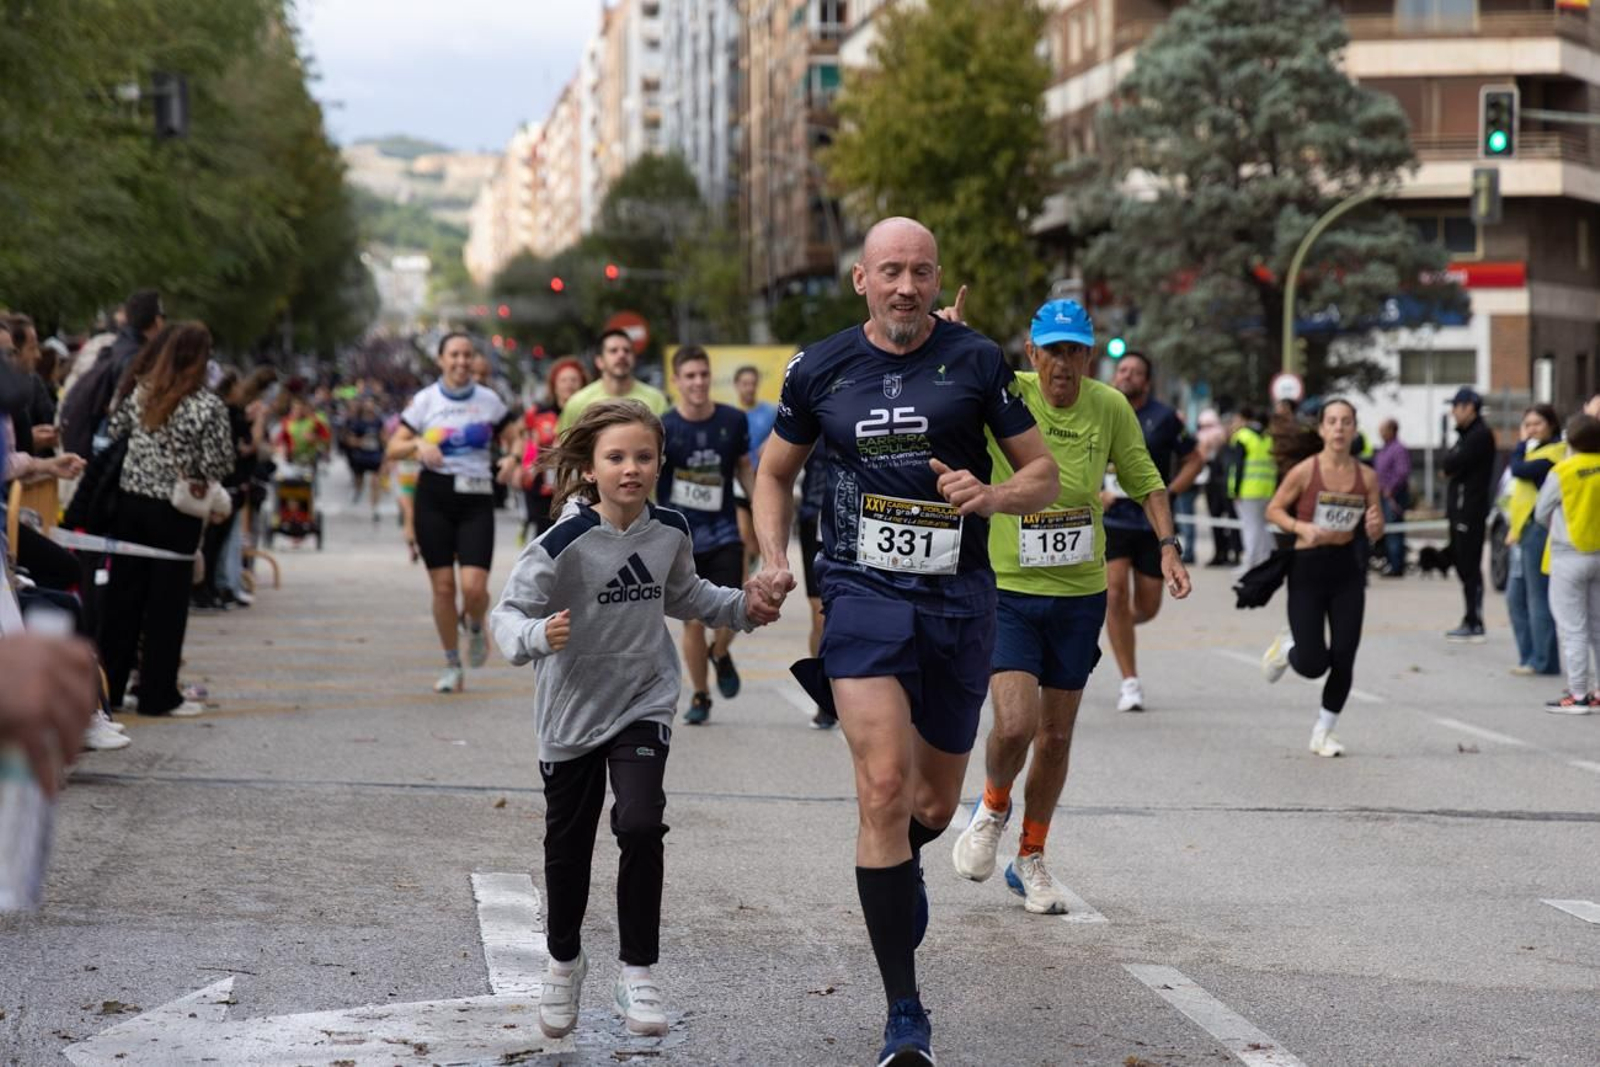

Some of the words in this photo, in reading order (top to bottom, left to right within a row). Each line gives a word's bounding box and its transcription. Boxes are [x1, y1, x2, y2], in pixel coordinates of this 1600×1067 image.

[855, 406, 929, 438] 25
[856, 433, 928, 448] CARRERA
[684, 485, 712, 503] 106
[864, 496, 887, 513] XXV
[887, 501, 922, 512] CARREA
[877, 526, 934, 558] 331
[1037, 530, 1082, 553] 187
[597, 583, 662, 605] adidas
